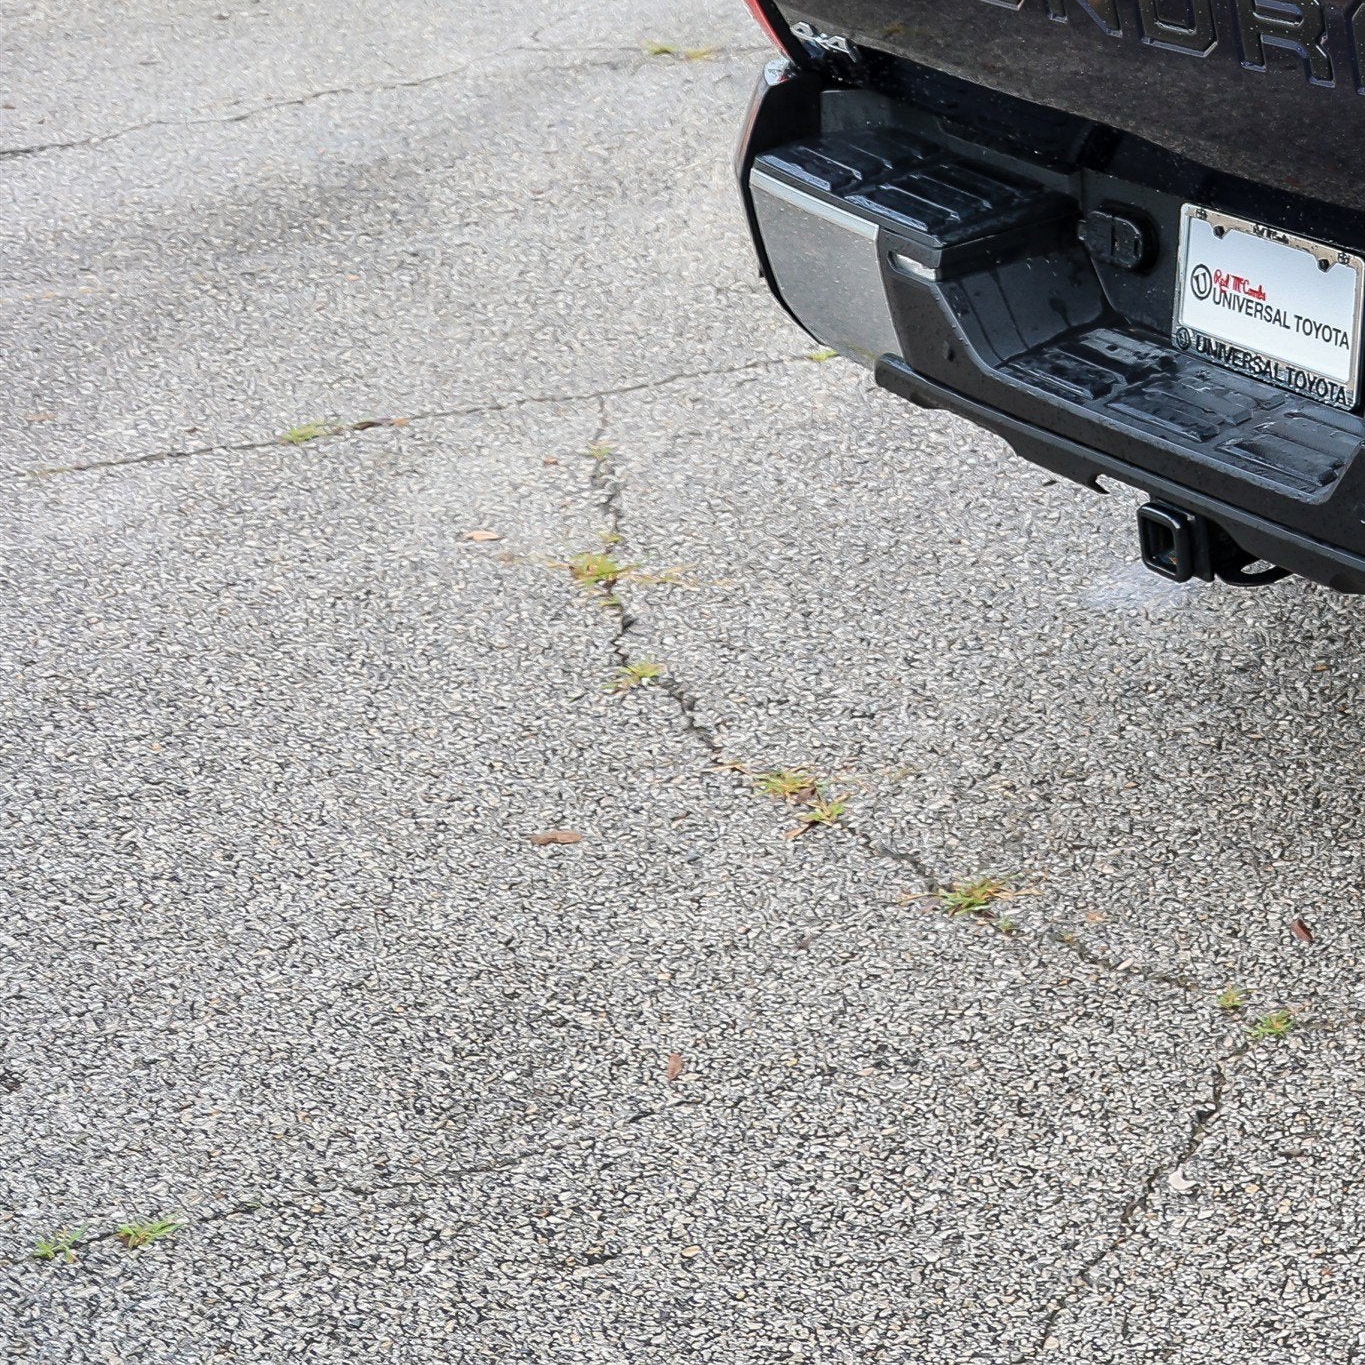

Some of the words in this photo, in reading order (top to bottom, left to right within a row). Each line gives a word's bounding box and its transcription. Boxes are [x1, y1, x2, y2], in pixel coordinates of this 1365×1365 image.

[1212, 287, 1291, 330] UNIVERSAL
[1294, 314, 1350, 350] TOYOTA
[1196, 334, 1284, 383] UNIVERSAL
[1286, 366, 1348, 406] TOYOTA
